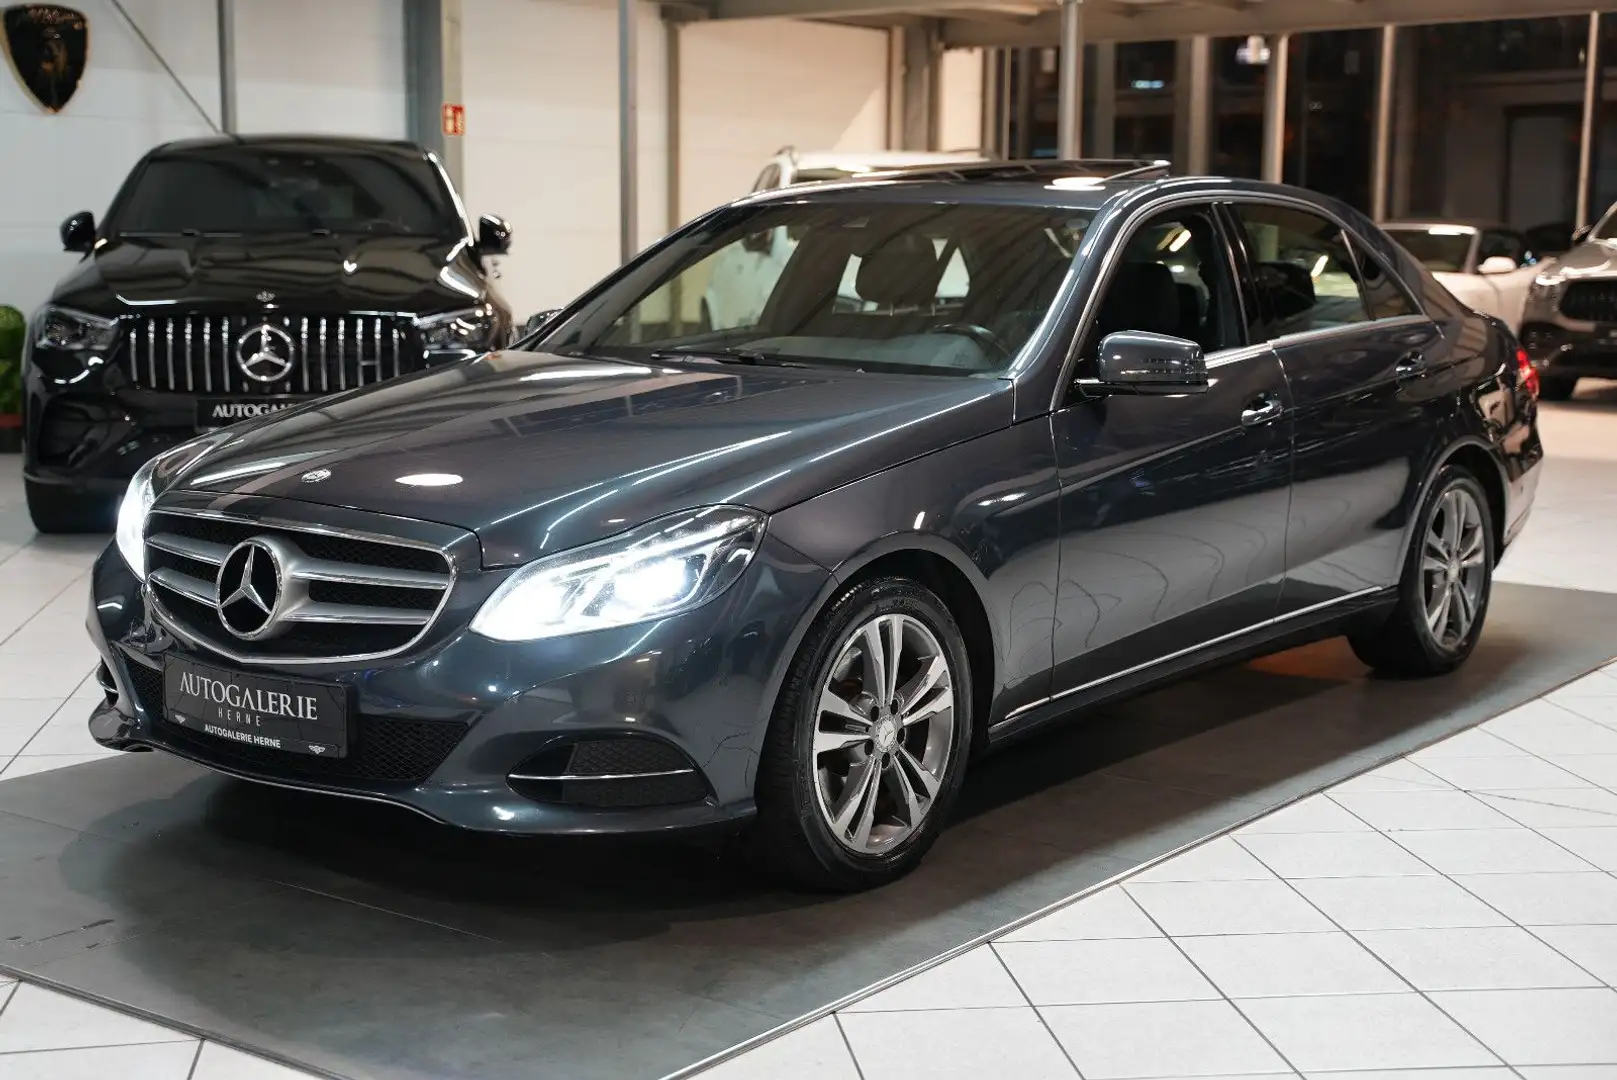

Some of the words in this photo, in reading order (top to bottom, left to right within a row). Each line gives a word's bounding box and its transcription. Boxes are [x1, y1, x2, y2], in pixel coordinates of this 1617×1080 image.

[180, 671, 318, 720] AUTOGALERIE
[218, 707, 261, 727] HERNE
[204, 723, 253, 743] AUTOGALERIE
[253, 735, 281, 749] HERNE
